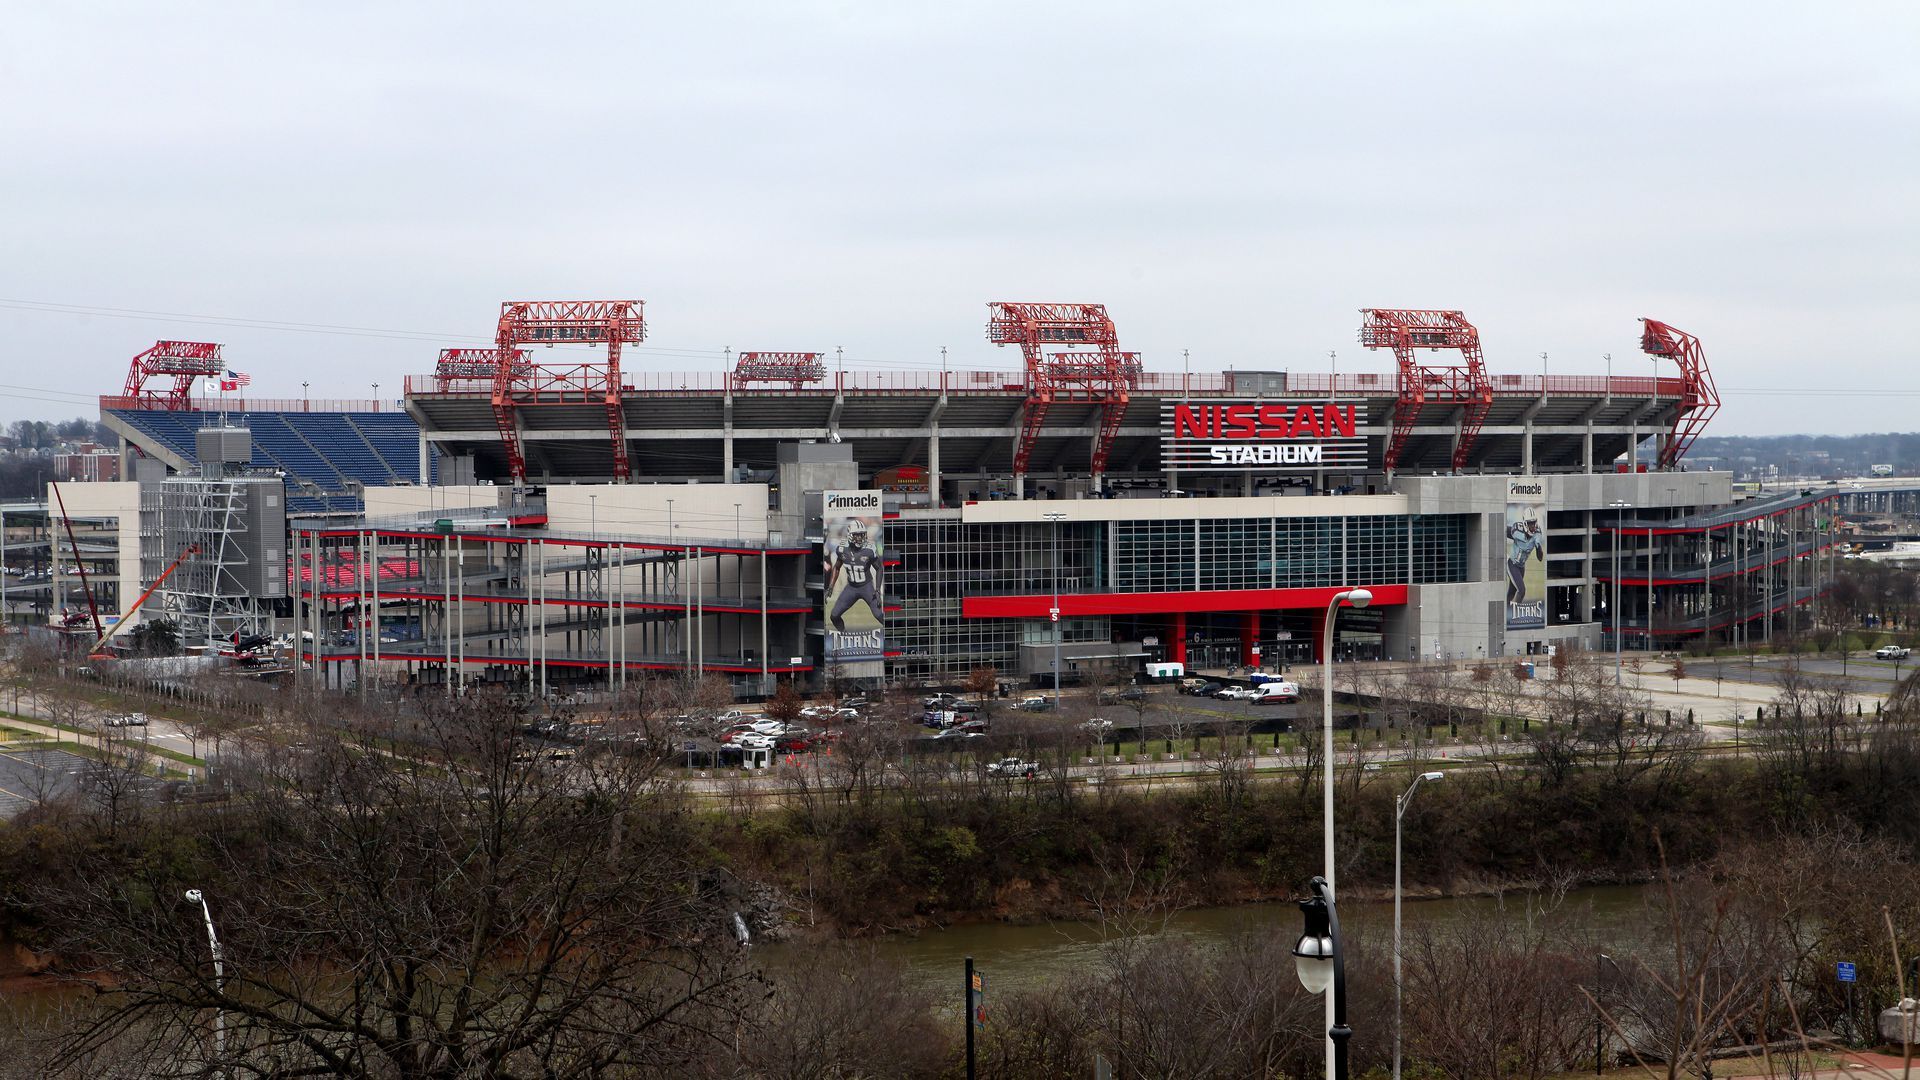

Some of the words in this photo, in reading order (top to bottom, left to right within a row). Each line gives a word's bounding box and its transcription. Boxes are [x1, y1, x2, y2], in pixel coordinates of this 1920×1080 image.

[1174, 404, 1356, 438] NISSAN
[1210, 446, 1322, 464] STADIUM
[1510, 482, 1542, 495] Pinnacle
[828, 494, 878, 508] Pinnacle
[1051, 613, 1058, 621] S
[1510, 600, 1542, 620] TITANS
[828, 628, 881, 651] TITANS
